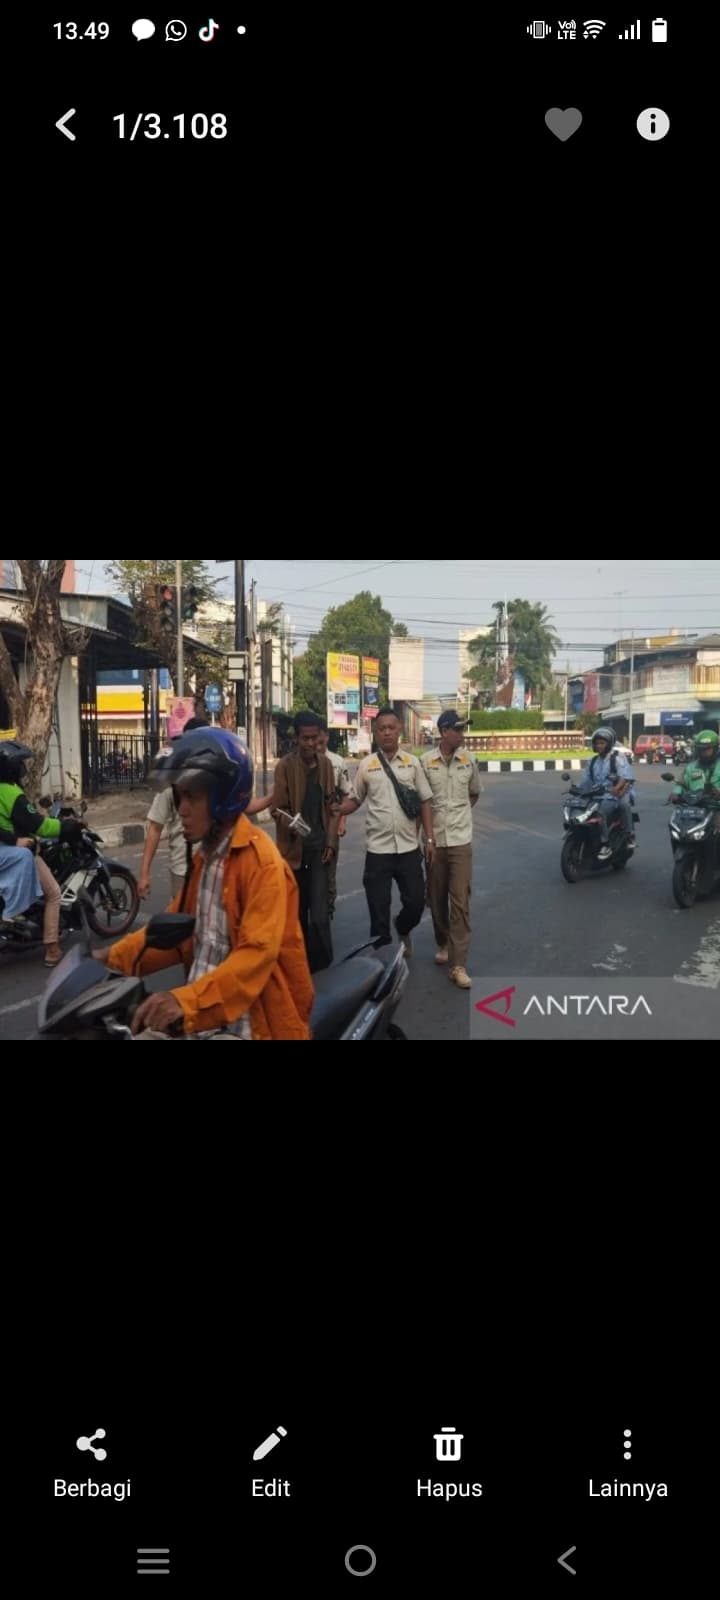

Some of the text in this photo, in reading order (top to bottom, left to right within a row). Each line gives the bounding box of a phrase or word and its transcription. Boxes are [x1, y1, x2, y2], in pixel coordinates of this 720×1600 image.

[53, 21, 110, 40] 13.49
[557, 30, 577, 40] LTE
[112, 112, 228, 141] 1/3.108
[53, 1477, 132, 1502] Berbagi
[252, 1477, 291, 1497] Edit
[417, 1478, 483, 1502] Hapus
[589, 1478, 668, 1502] Lainnya
